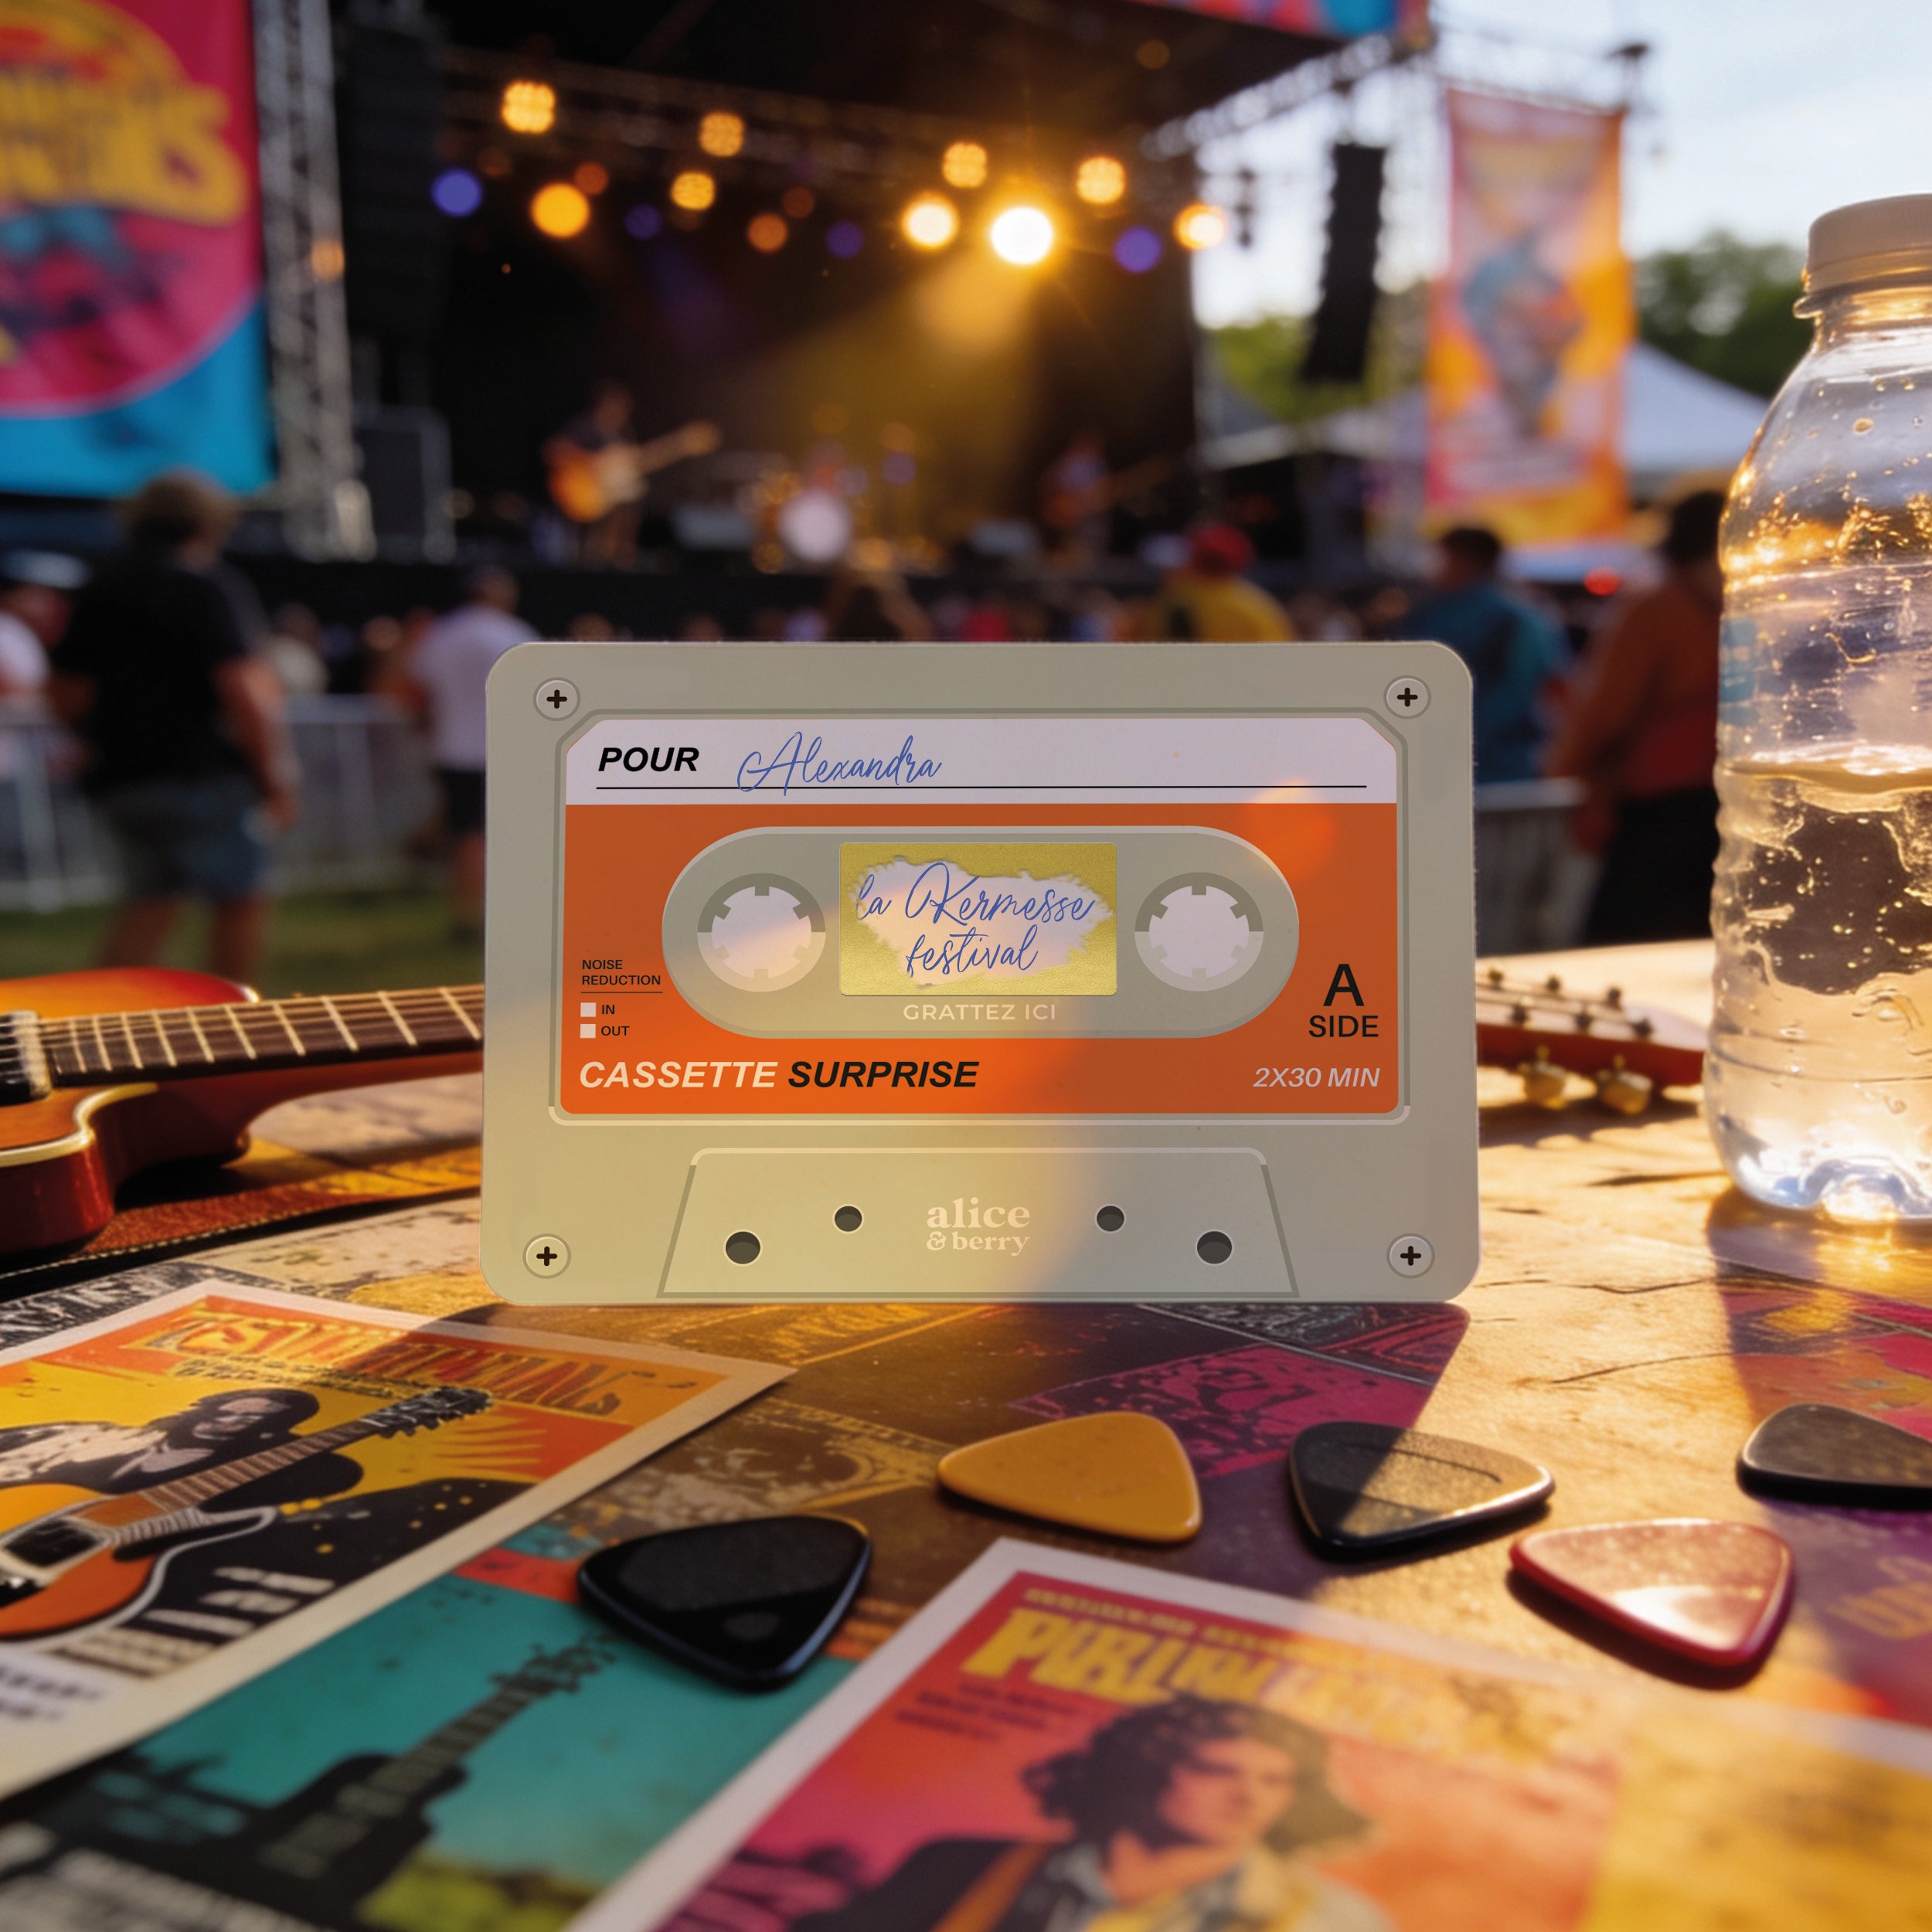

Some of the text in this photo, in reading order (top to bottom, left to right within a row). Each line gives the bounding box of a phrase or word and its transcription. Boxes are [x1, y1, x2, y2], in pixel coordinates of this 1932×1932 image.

[598, 731, 942, 796] POUR Alexandra
[856, 862, 1096, 926] la Kermesse
[905, 924, 1039, 978] festival
[582, 959, 623, 969] NOISE
[581, 975, 661, 985] REDUCTION
[1323, 963, 1365, 1007] A
[600, 1005, 615, 1015] IN
[903, 1004, 1056, 1020] GRATTEZ ICI
[600, 1026, 630, 1036] OUT
[1308, 1015, 1379, 1038] SIDE
[580, 1061, 979, 1088] CASSETTE SURPRISE
[1253, 1067, 1380, 1087] 2X30 MIN
[927, 1196, 1031, 1229] alice
[927, 1230, 1030, 1257] & berry
